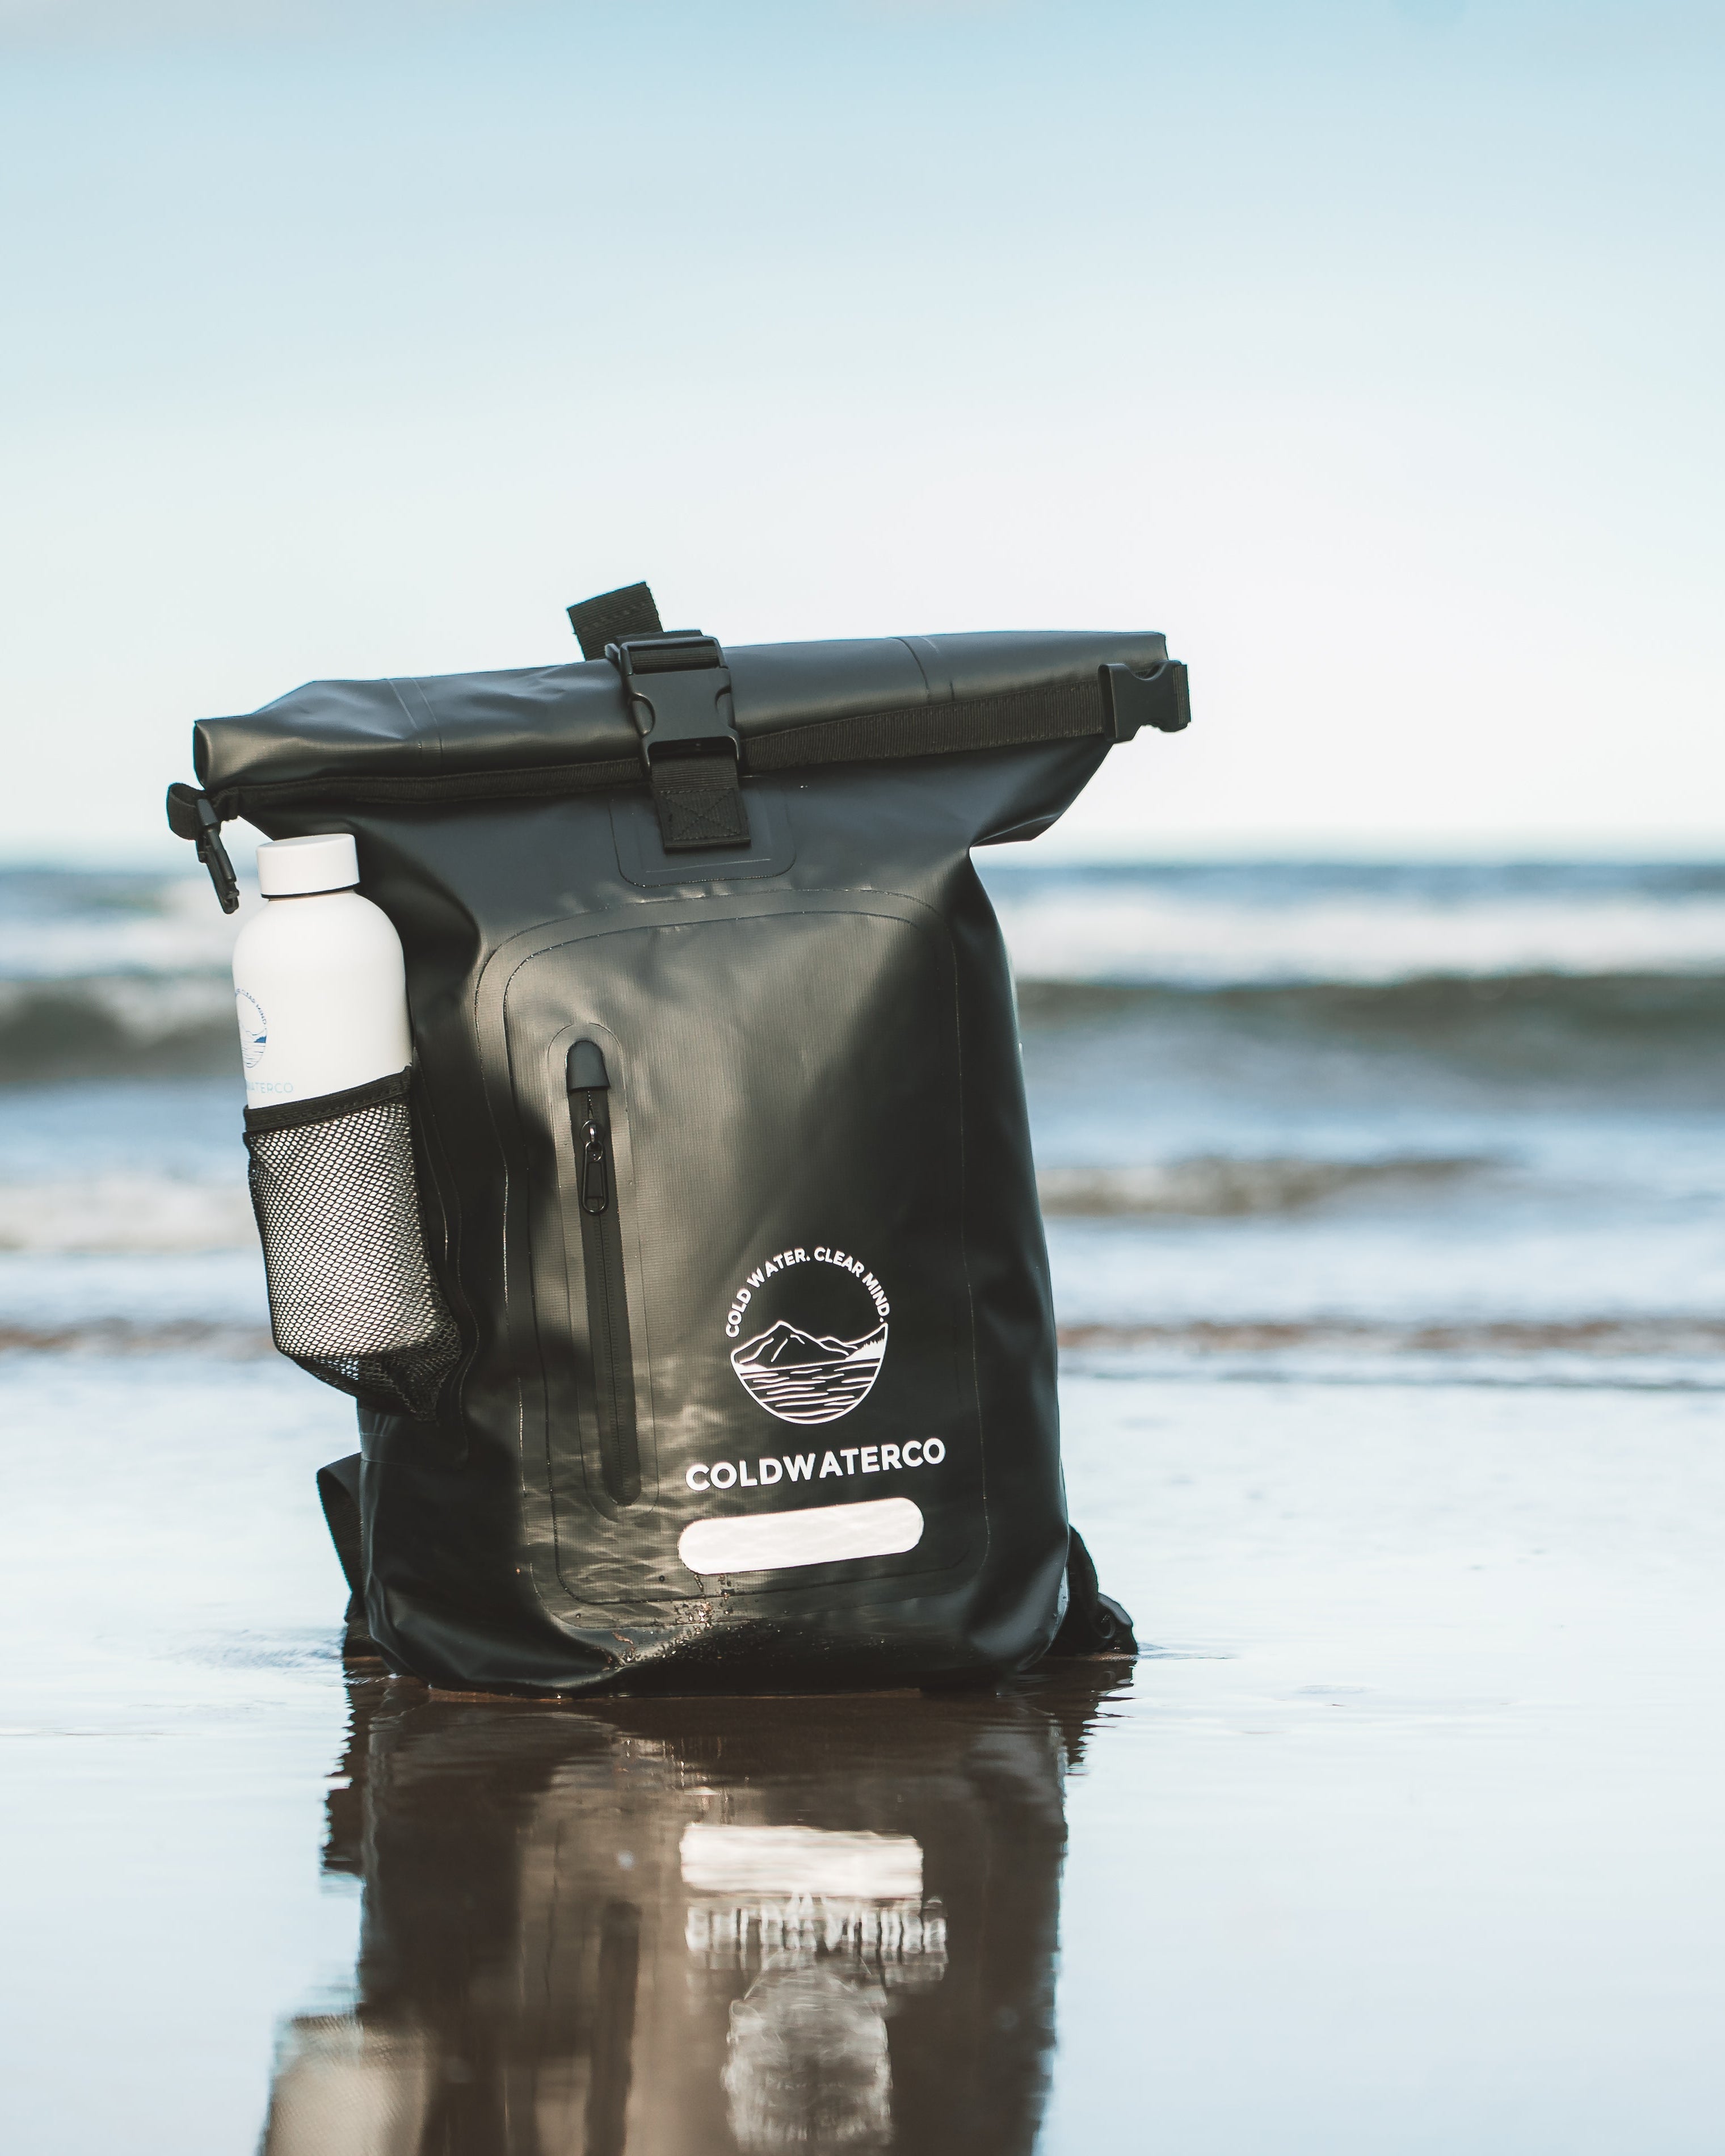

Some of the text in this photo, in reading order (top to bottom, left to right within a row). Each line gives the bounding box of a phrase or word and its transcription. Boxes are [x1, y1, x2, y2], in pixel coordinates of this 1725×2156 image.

[725, 1246, 890, 1338] COLD WATER. CLEAR MIND.
[685, 1437, 946, 1492] COLDWATERCO
